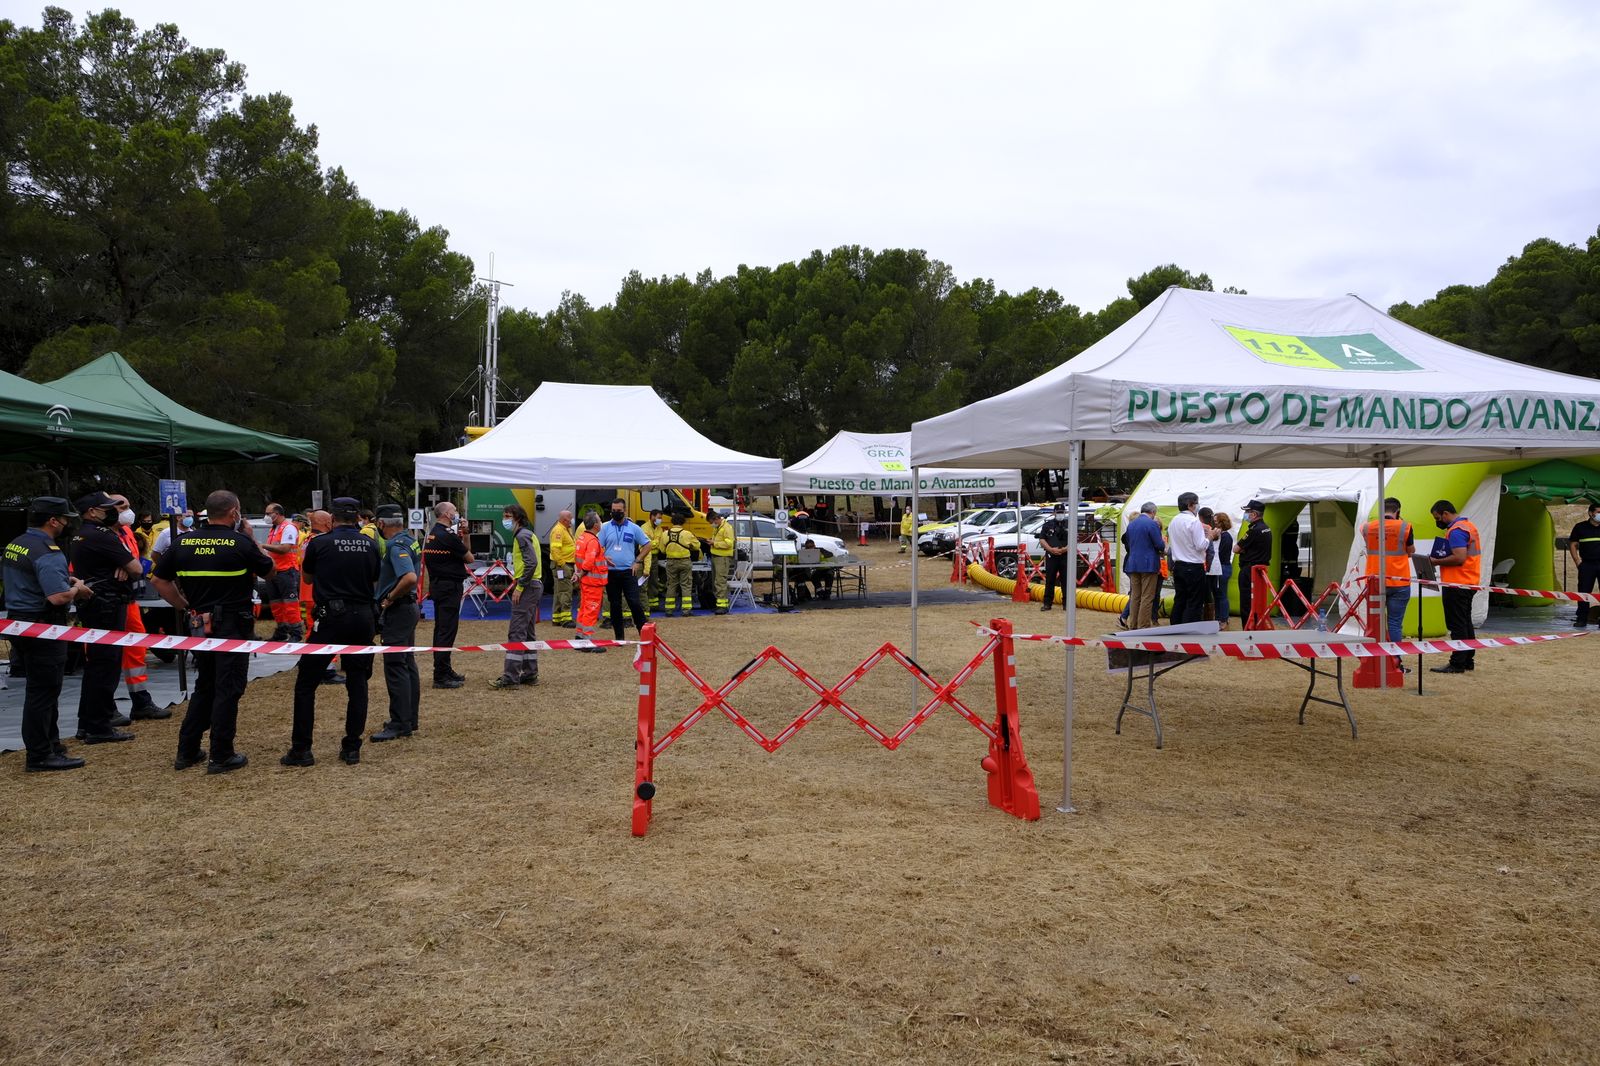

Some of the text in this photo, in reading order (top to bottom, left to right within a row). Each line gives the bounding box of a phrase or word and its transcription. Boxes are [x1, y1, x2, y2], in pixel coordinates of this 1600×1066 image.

[1245, 338, 1309, 355] 112
[1127, 389, 1600, 431] PUESTO DE MANDO AVANZ
[867, 449, 905, 458] GREA
[809, 477, 996, 491] Puesto de Mano Avanzado
[180, 538, 236, 546] EMERGENCIAS
[194, 547, 216, 555] ADRA
[338, 545, 368, 553] LOCAL
